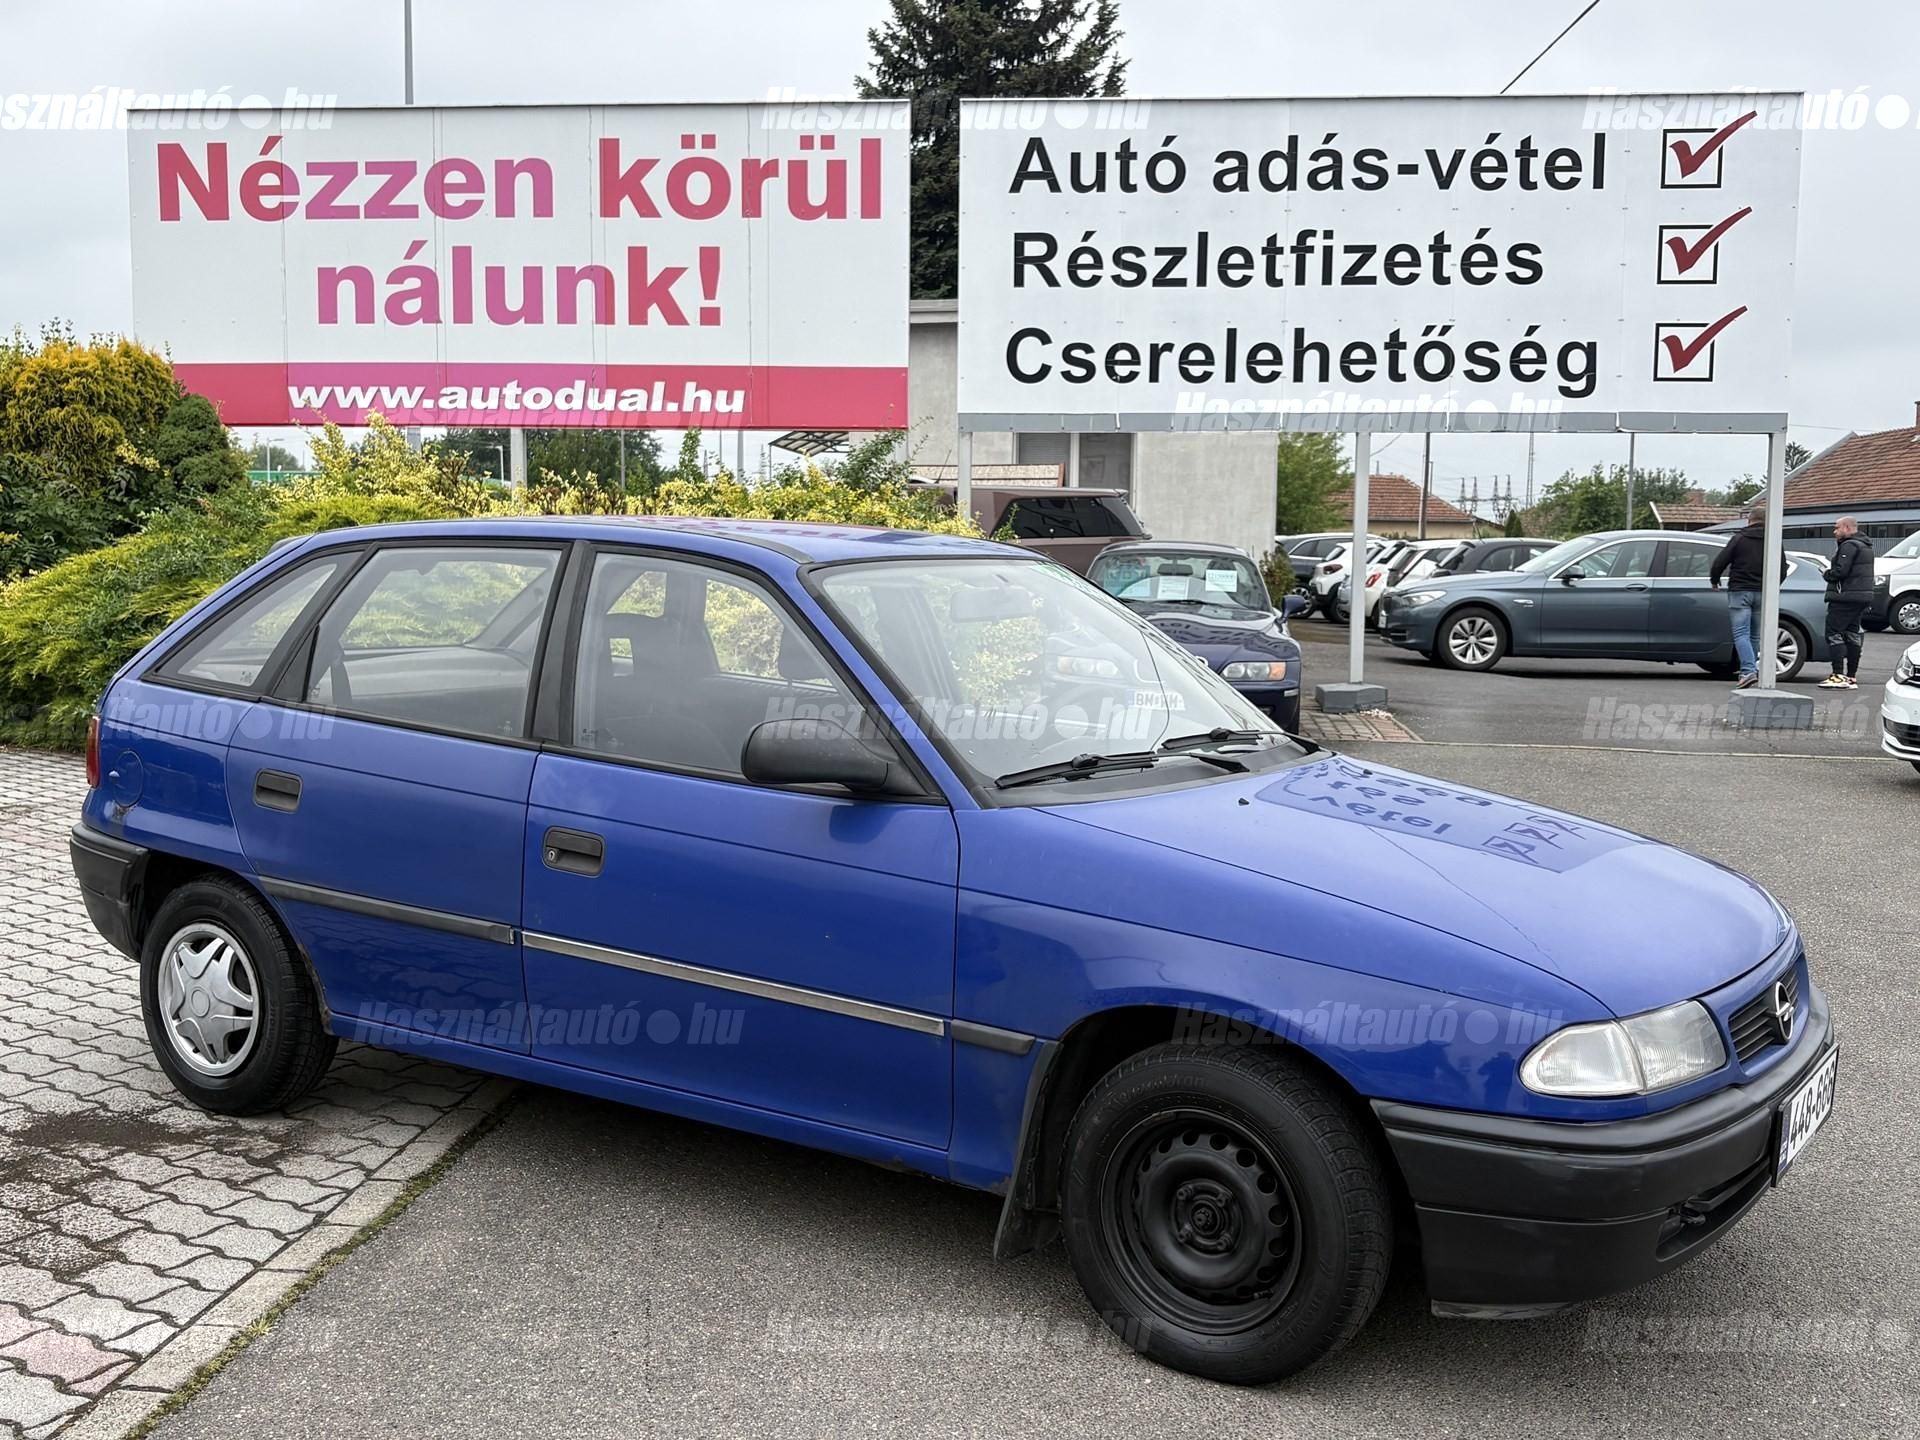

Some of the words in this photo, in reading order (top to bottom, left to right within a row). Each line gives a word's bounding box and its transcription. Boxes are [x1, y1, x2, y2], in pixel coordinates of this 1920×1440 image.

[158, 136, 553, 221] Nézzen
[600, 133, 881, 221] körül
[1009, 135, 1187, 194] Autó
[1213, 132, 1606, 193] adás-vétel
[318, 240, 722, 326] nálunk!
[1013, 227, 1544, 288] Részletfizetés
[1006, 325, 1597, 399] Cserelehetőség
[288, 380, 745, 413] www.autodual.hu
